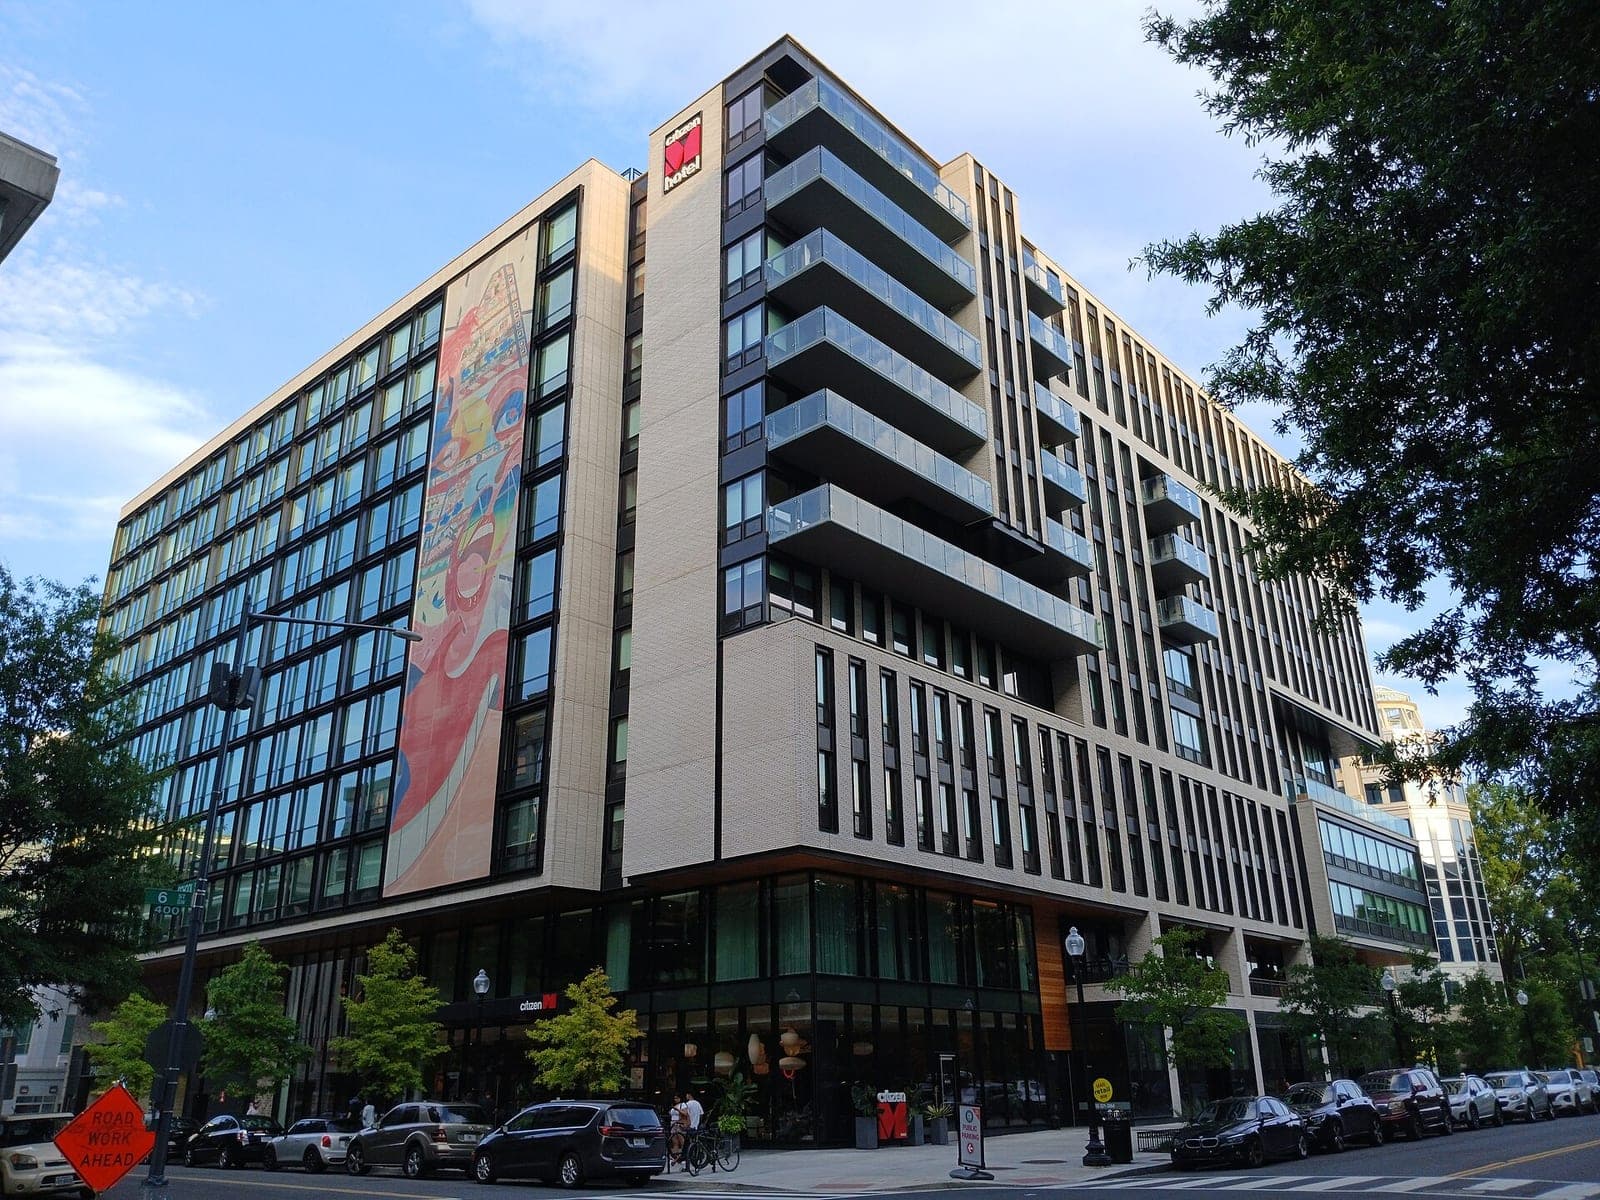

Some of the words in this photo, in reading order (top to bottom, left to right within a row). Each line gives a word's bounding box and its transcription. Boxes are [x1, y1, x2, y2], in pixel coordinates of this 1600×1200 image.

[664, 155, 700, 191] hotel
[158, 891, 168, 904] 6
[155, 906, 180, 915] 400
[877, 1090, 907, 1103] citizen
[91, 1111, 134, 1126] ROAD
[87, 1131, 132, 1147] WORK
[80, 1152, 134, 1168] AHEAD
